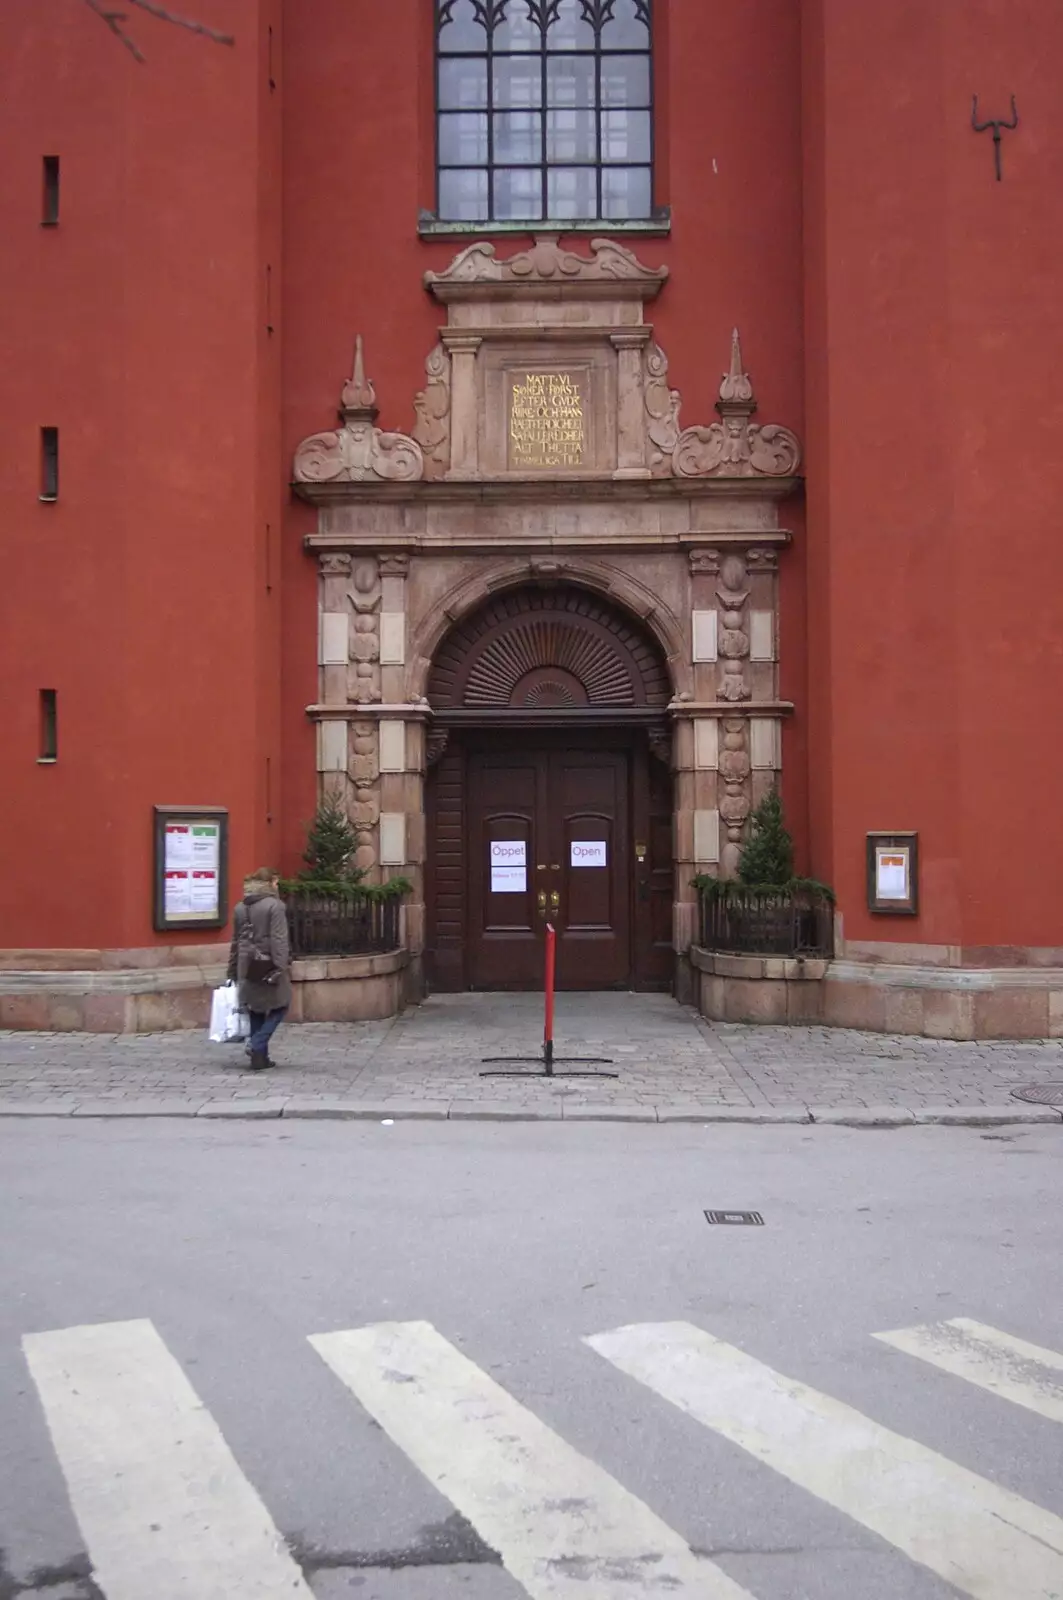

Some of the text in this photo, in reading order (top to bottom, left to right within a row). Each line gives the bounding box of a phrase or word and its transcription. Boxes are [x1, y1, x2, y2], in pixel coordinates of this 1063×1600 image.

[526, 374, 555, 386] MATT
[492, 844, 525, 858] Öppet
[572, 846, 601, 858] Open
